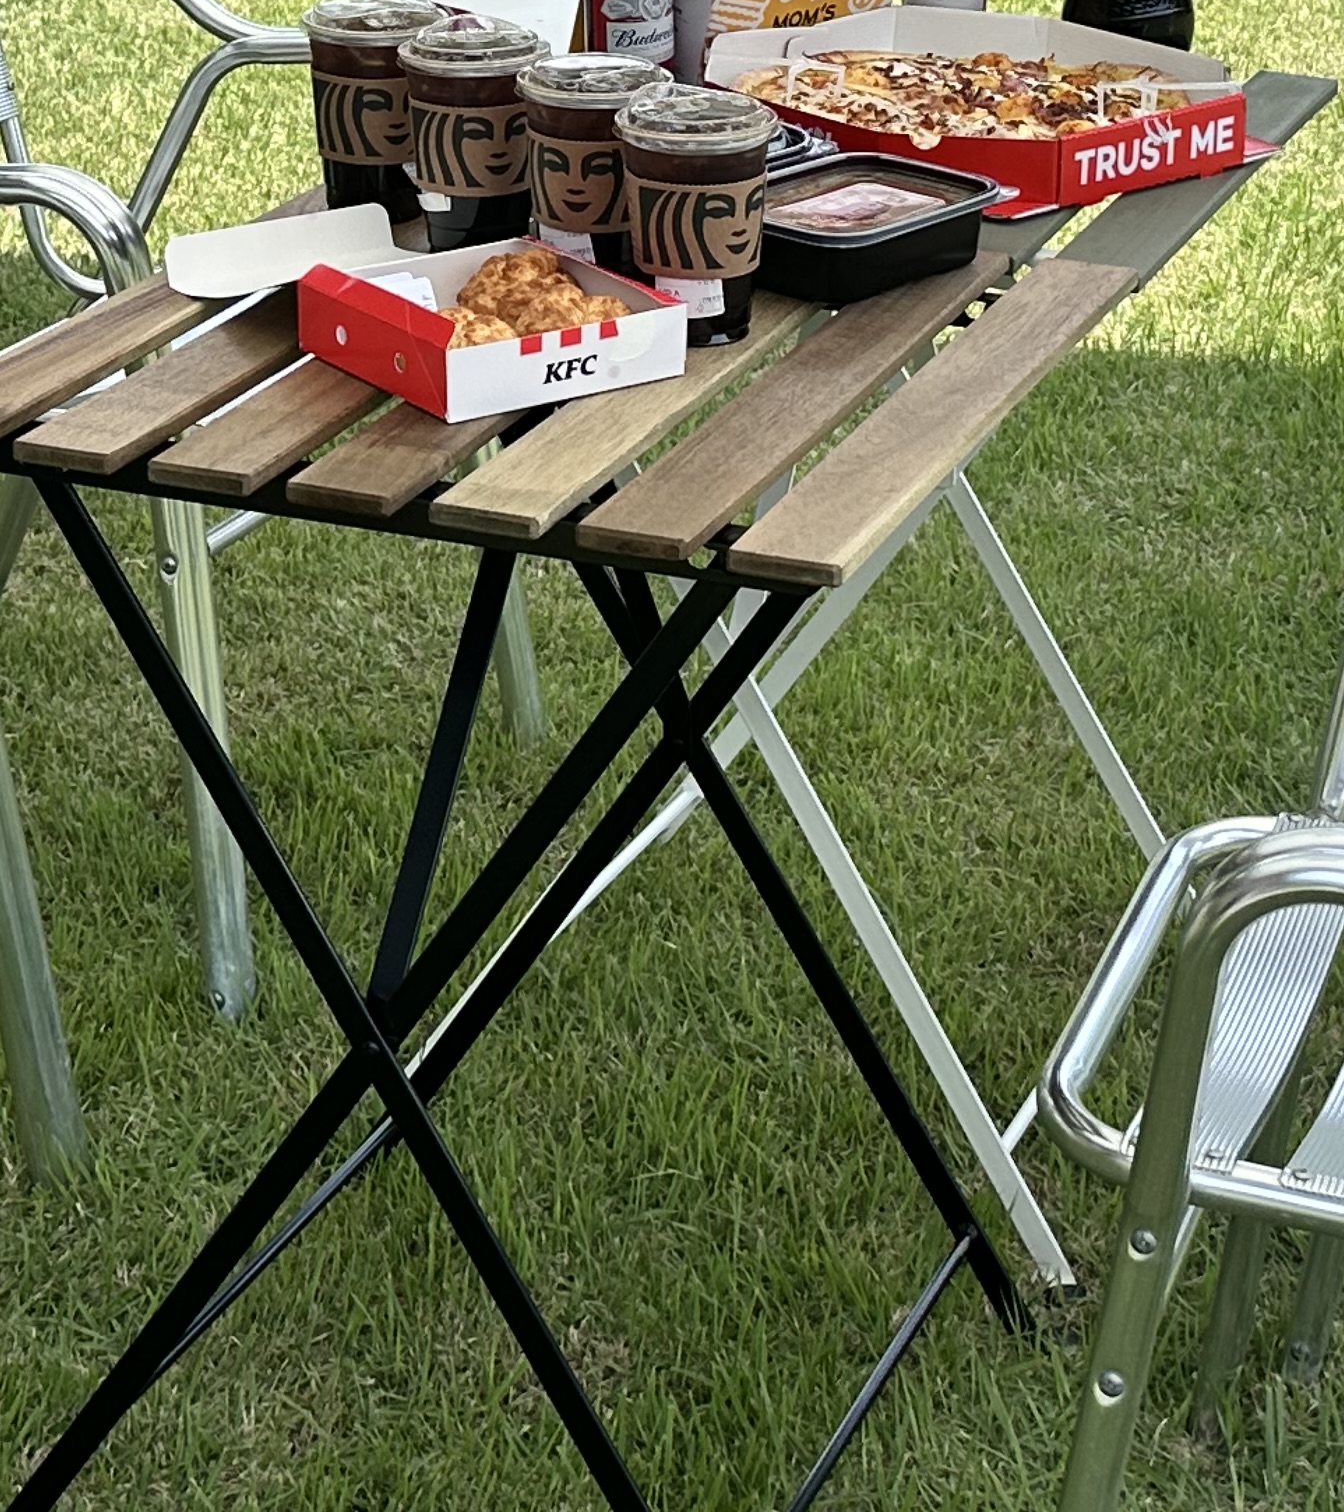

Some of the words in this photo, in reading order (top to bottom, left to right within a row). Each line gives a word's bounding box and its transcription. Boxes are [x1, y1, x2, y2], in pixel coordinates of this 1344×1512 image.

[772, 2, 837, 29] MOM'S
[1074, 128, 1182, 186] TRUST
[1189, 115, 1235, 159] ME
[543, 354, 598, 385] KFC
